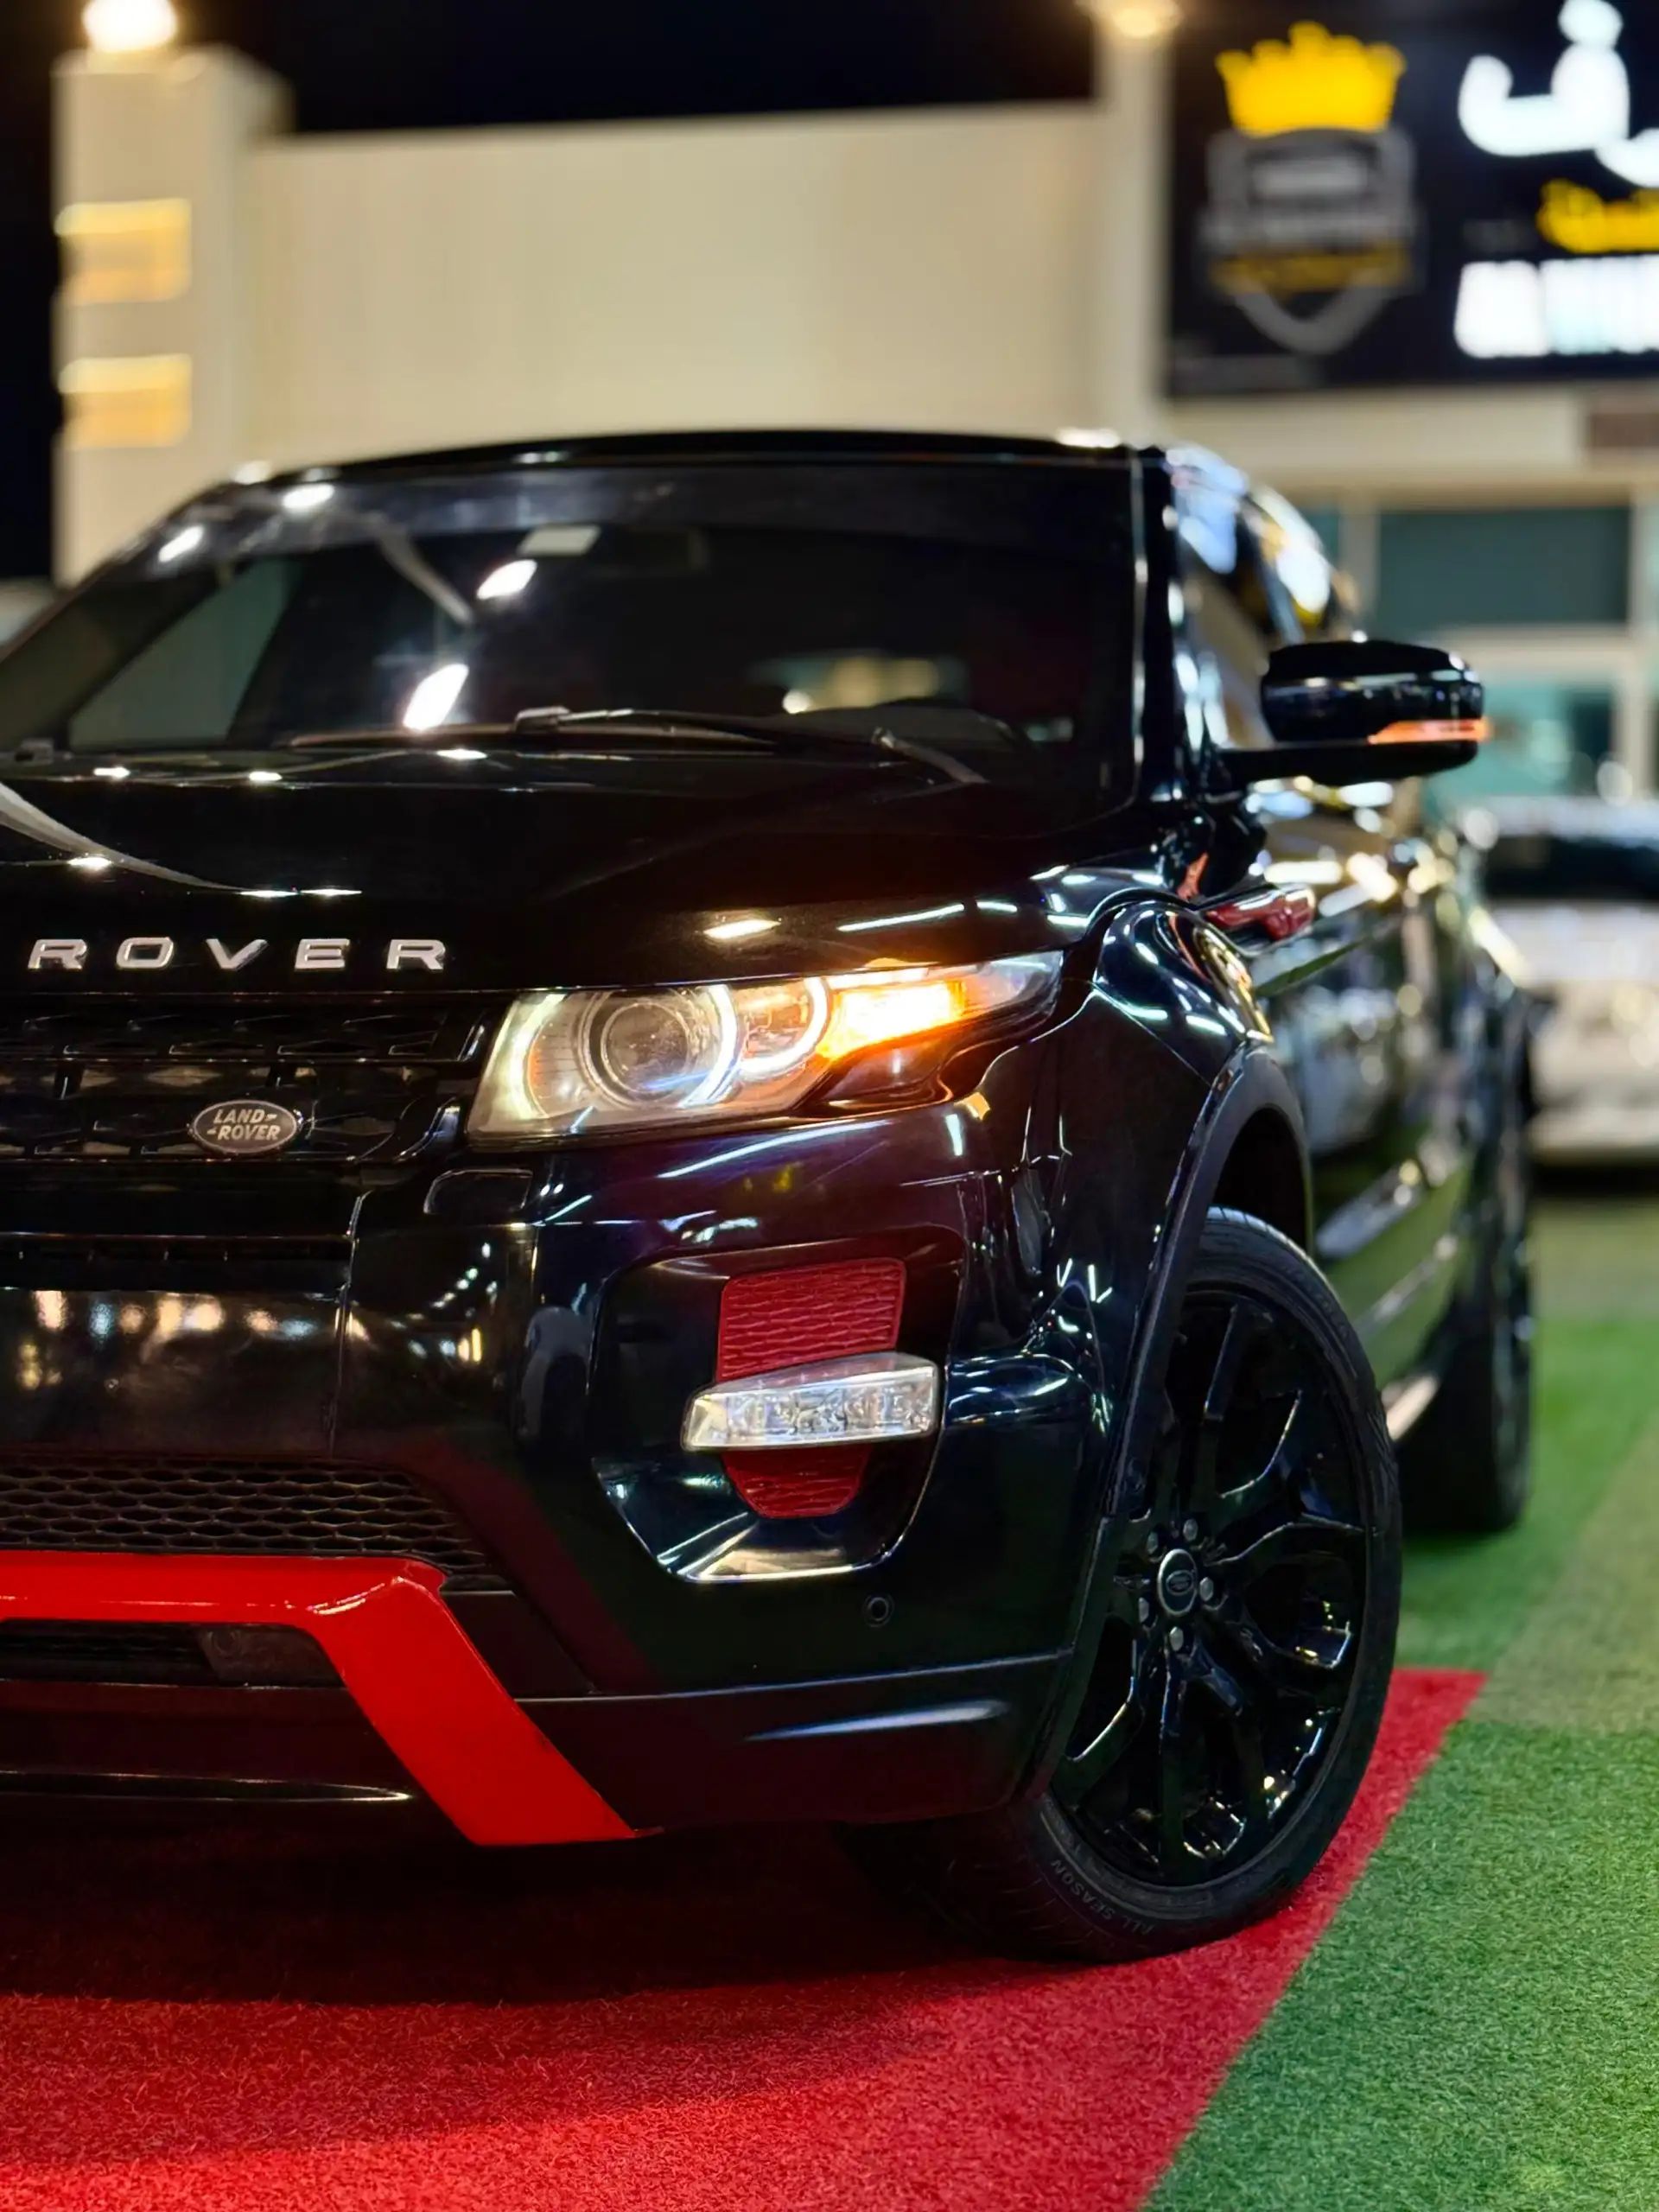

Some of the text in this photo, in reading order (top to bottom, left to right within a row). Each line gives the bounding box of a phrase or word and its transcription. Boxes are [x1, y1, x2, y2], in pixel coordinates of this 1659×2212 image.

[28, 937, 446, 971] ROVER
[1050, 1859, 1155, 1936] ALL SEASON
